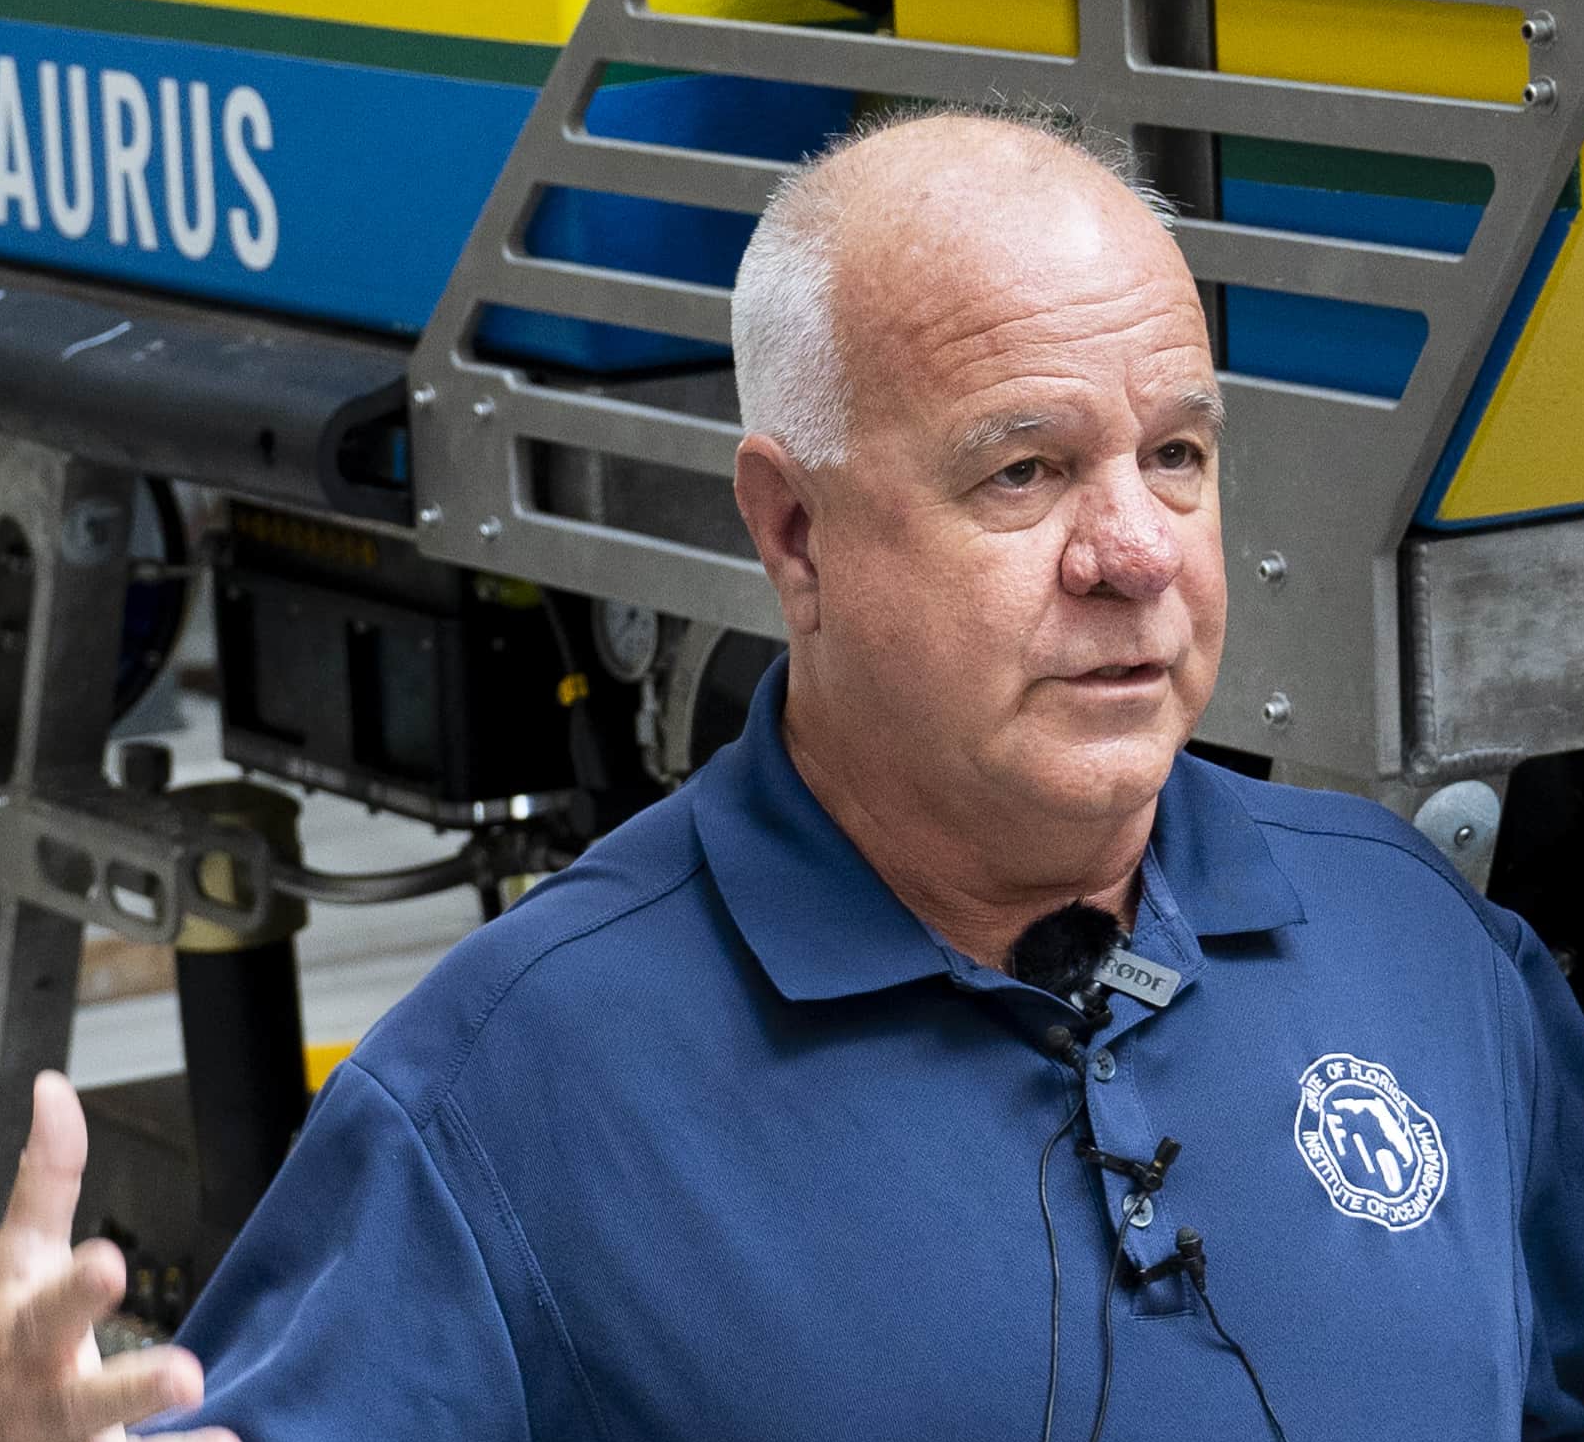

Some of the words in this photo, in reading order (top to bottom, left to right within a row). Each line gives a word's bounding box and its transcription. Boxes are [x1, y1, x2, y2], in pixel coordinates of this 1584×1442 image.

[1326, 1061, 1346, 1080] OF
[1349, 1061, 1408, 1113] FLORIDA
[1302, 1130, 1365, 1210] INSTITUTE
[1366, 1197, 1391, 1218] OF
[1388, 1122, 1442, 1223] OCEANOGRAPHY
